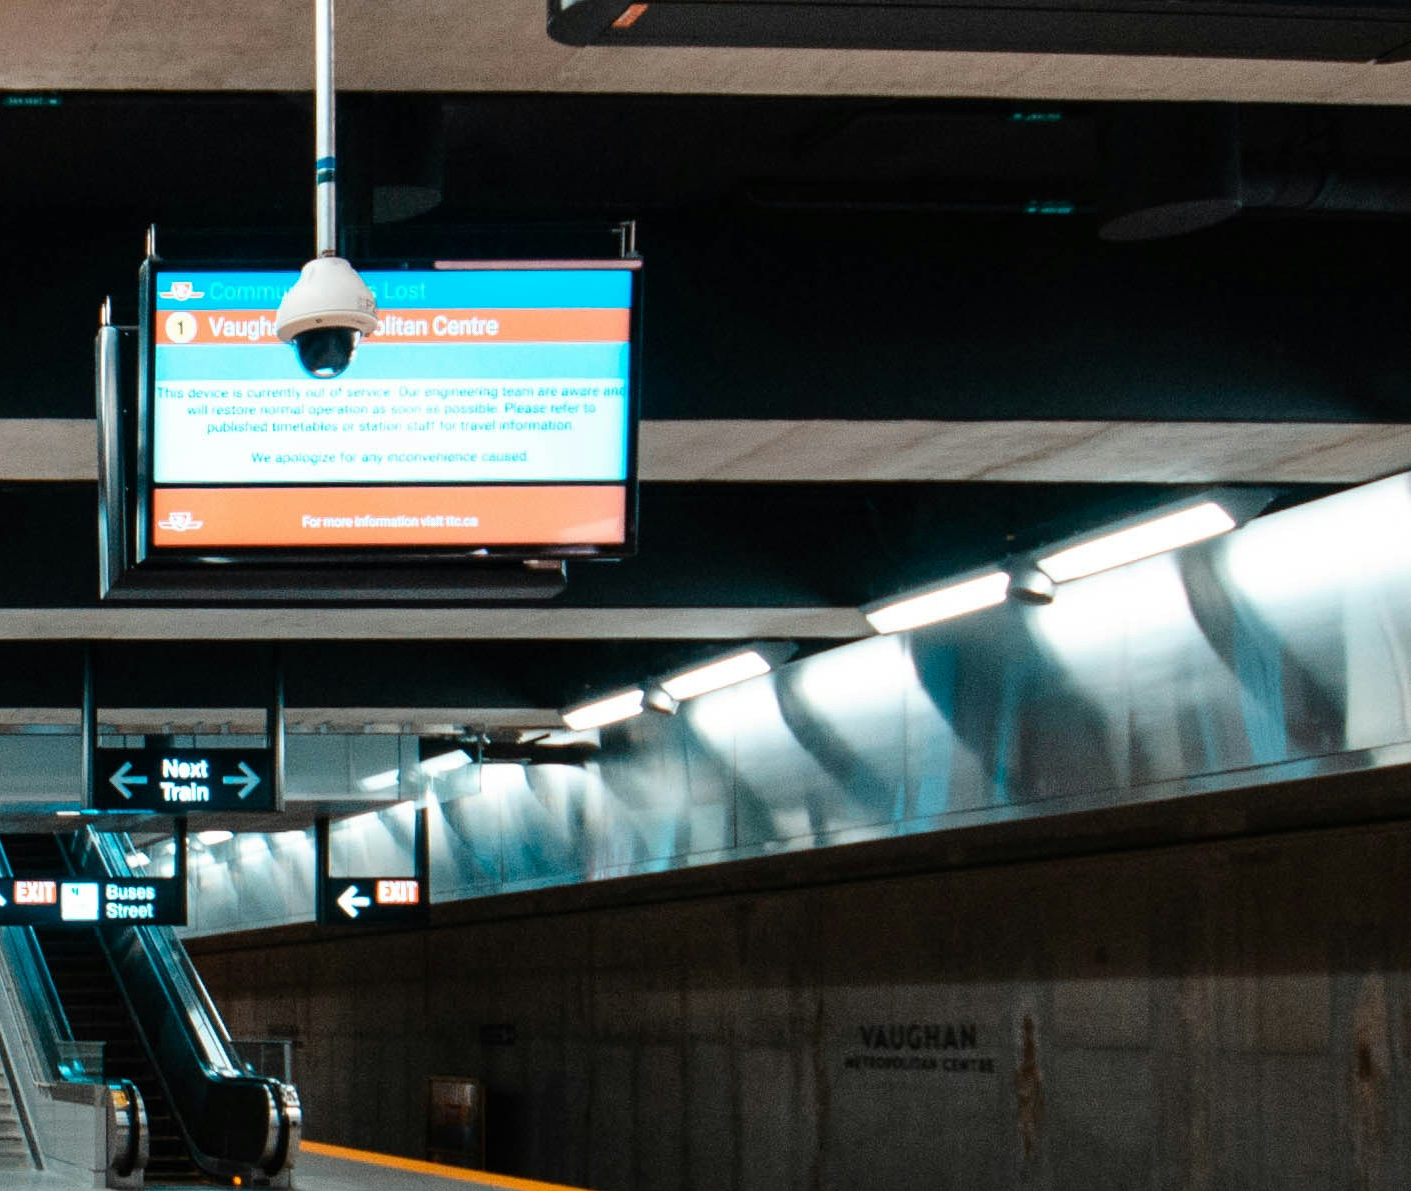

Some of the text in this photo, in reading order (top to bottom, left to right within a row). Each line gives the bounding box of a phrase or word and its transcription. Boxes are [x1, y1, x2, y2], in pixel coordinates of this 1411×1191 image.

[384, 282, 426, 299] Lost
[177, 320, 184, 336] 1
[432, 315, 499, 337] Centre
[157, 386, 184, 398] This
[188, 387, 228, 398] device
[232, 387, 243, 398] is
[247, 387, 301, 400] currently
[305, 387, 325, 398] out
[329, 386, 343, 398] of
[398, 385, 419, 397] Our
[424, 386, 498, 400] engineering
[502, 386, 534, 397] team
[537, 386, 558, 397] are
[561, 386, 600, 397] aware
[187, 404, 208, 415] will
[211, 404, 257, 415] restore
[260, 403, 305, 415] normal
[308, 403, 368, 417] operation
[372, 405, 386, 415] as
[390, 405, 422, 415] soon
[504, 401, 547, 414] Please
[550, 402, 579, 414] refer
[583, 402, 597, 414] to
[207, 421, 268, 435] published
[272, 420, 338, 433] timetables
[342, 422, 354, 432] or
[358, 421, 401, 432] station
[406, 420, 436, 432] staff
[440, 420, 456, 432] for
[460, 419, 496, 431] travel
[251, 452, 272, 464] We
[275, 452, 336, 467] apologize
[340, 451, 356, 463] for
[361, 453, 383, 467] any
[386, 451, 478, 463] inconvenience
[302, 514, 479, 528] For more information visit ttc.ca
[161, 758, 209, 779] Next
[159, 781, 210, 802] Train
[16, 880, 56, 903] EXIT
[105, 884, 155, 900] Buses
[377, 880, 418, 902] EXIT
[105, 902, 154, 919] Street
[859, 1024, 977, 1050] VAUGHAN
[943, 1057, 994, 1073] CENTRE
